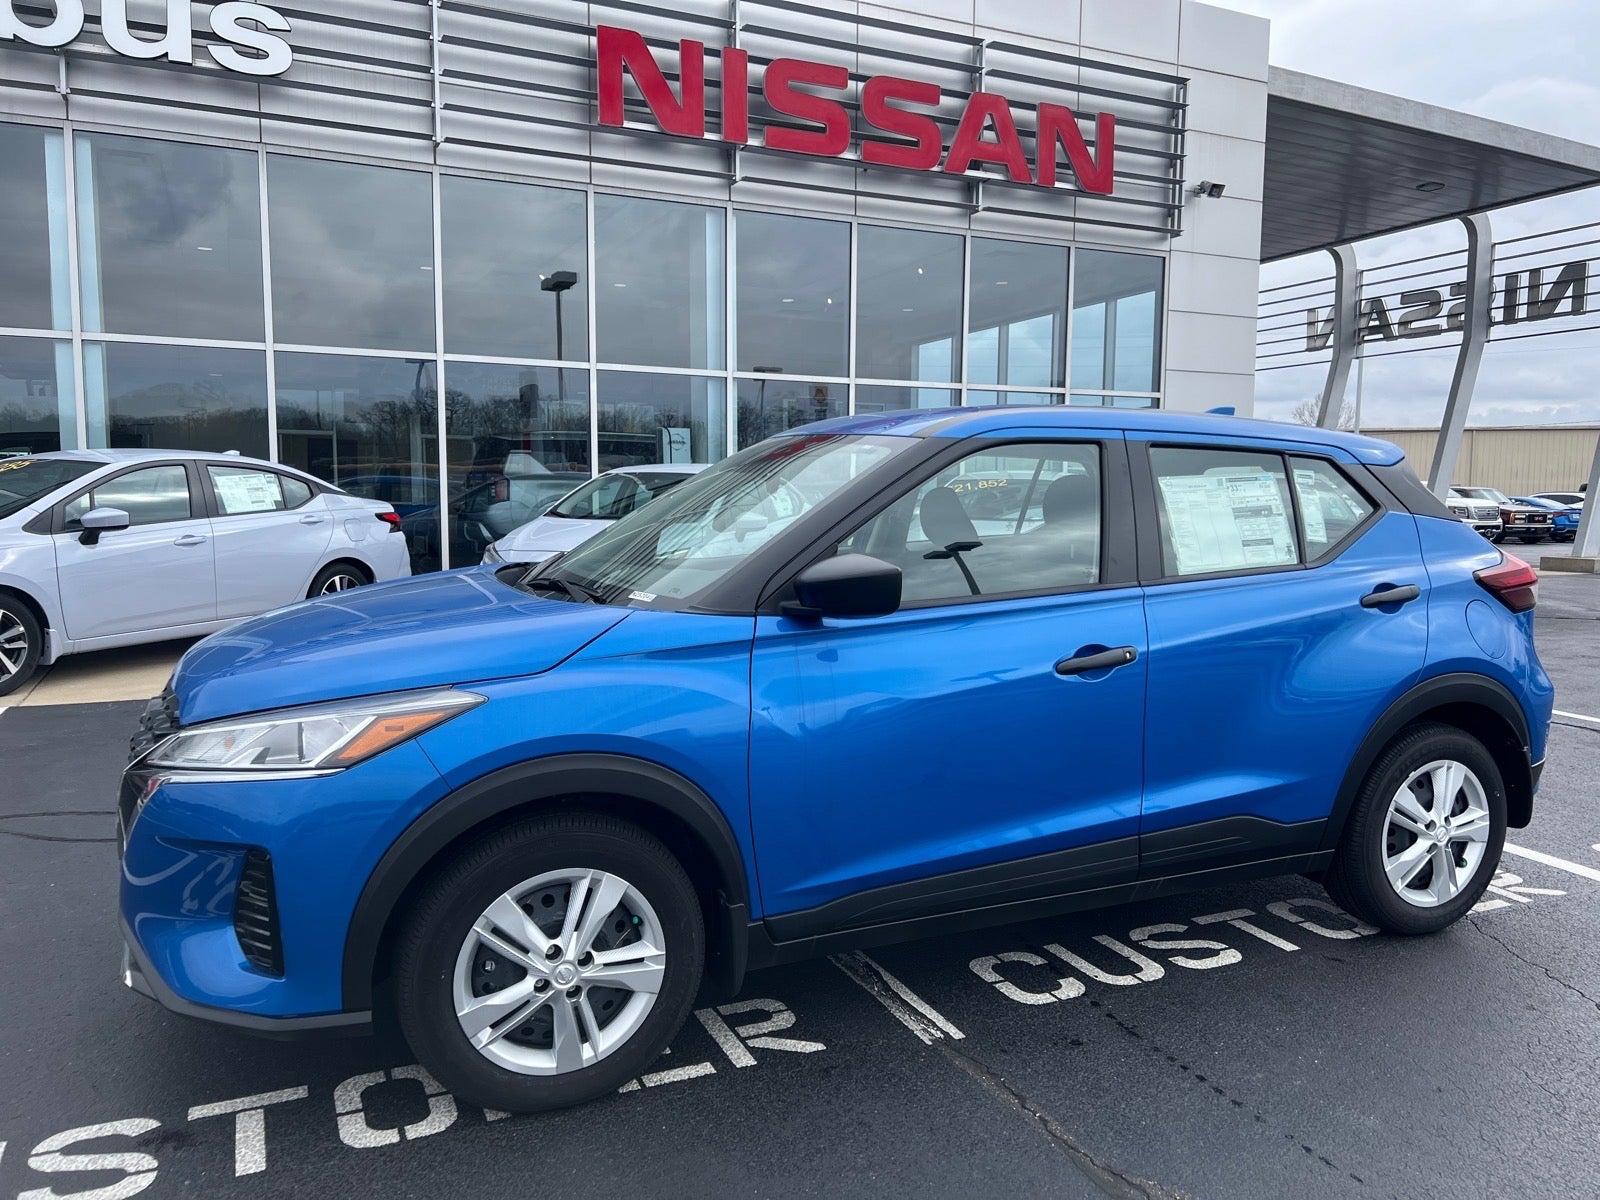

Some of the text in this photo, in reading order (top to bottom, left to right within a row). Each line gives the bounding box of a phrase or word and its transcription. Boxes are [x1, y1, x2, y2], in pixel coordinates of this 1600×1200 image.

[596, 25, 1115, 195] NISSAN
[968, 868, 1567, 1006] CUSTOR
[0, 998, 827, 1200] STOR
